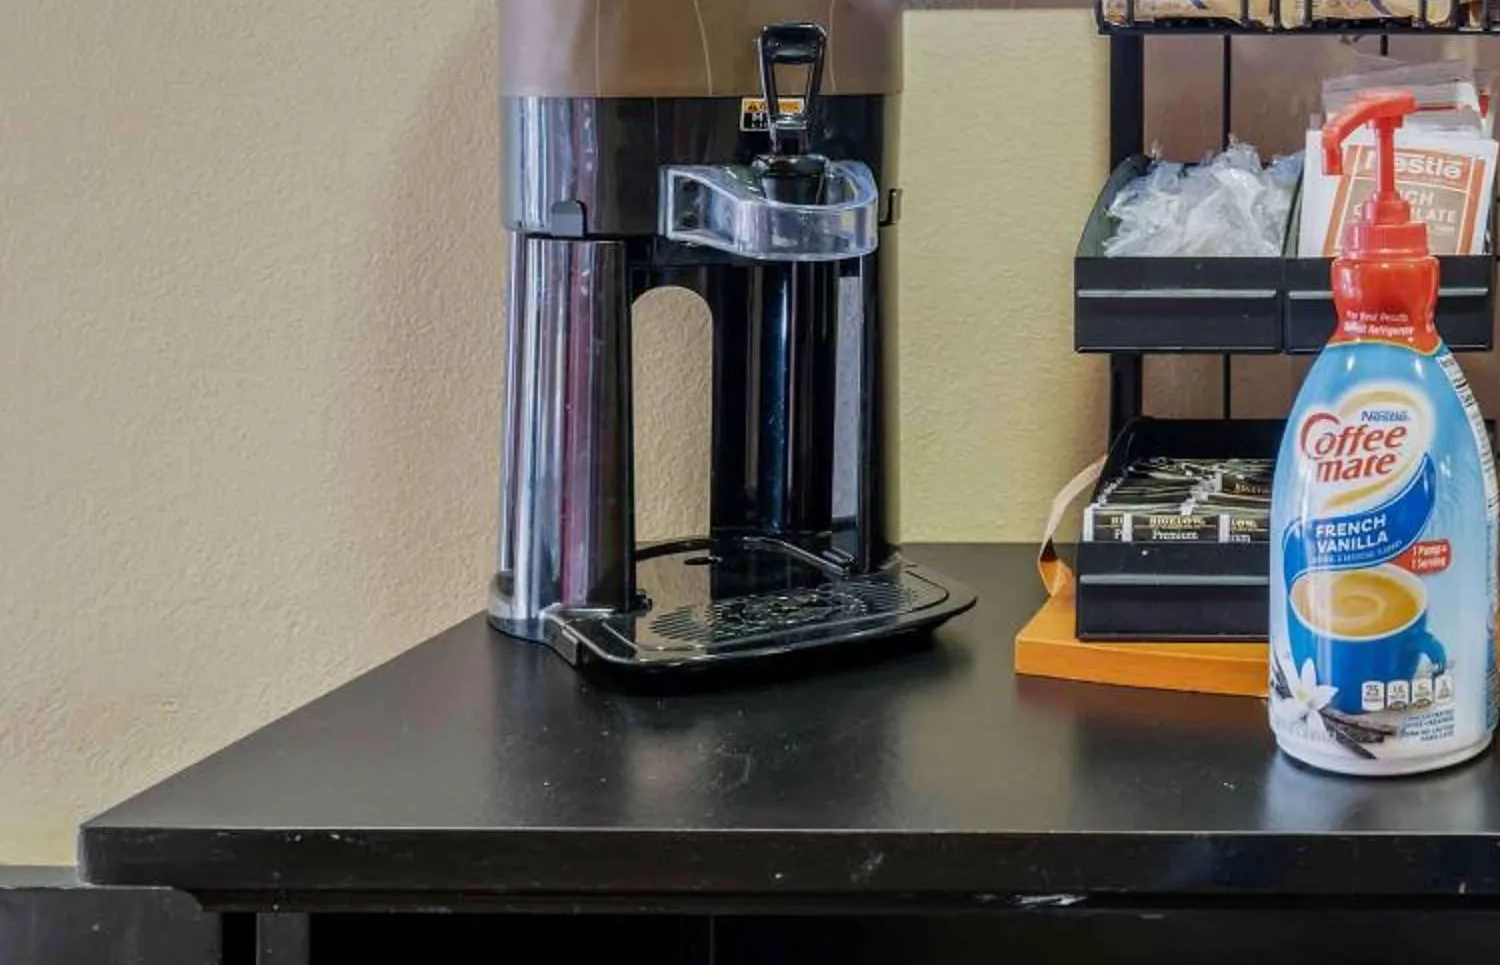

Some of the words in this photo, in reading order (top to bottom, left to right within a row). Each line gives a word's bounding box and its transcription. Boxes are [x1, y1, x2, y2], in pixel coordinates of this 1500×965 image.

[1300, 412, 1407, 461] Coffee
[1316, 453, 1396, 483] mate
[1315, 513, 1387, 538] FRENCH
[1316, 530, 1389, 554] VANILLA
